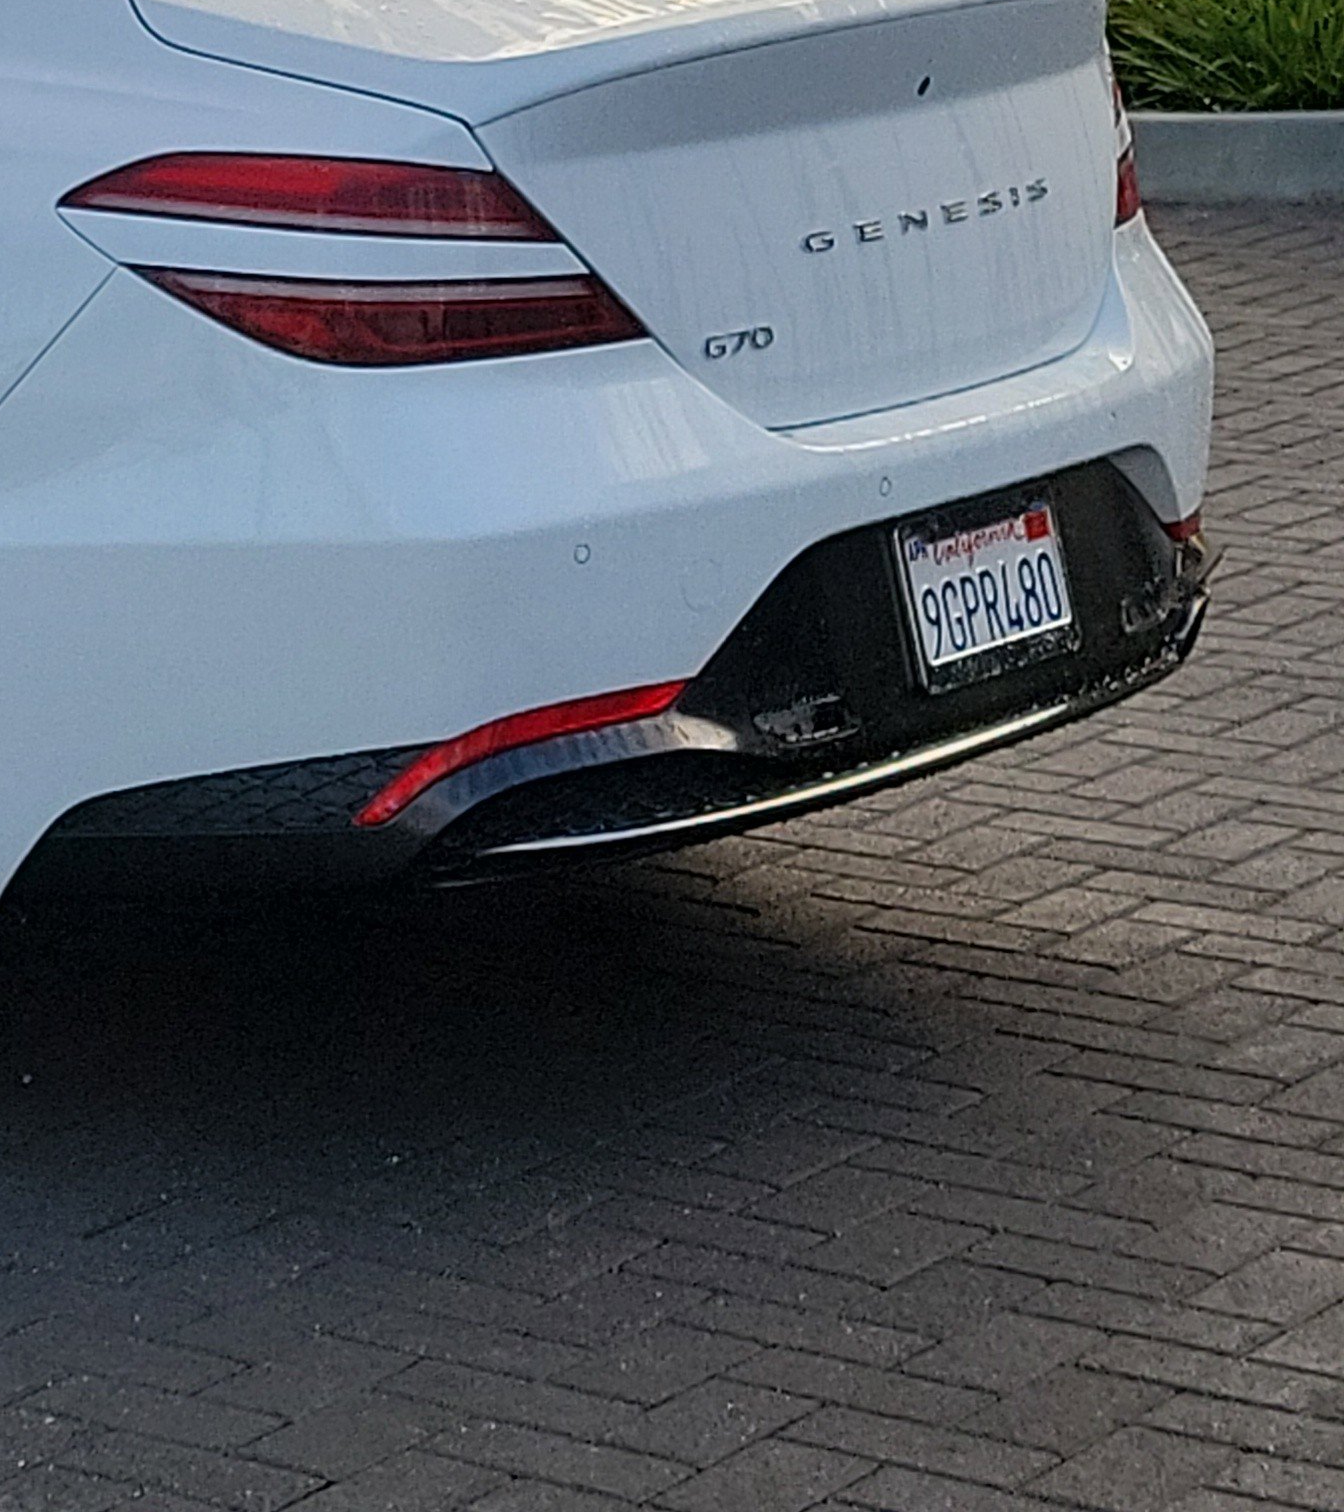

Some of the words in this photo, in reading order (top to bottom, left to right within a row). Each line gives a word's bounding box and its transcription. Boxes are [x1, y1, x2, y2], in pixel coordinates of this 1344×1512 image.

[800, 177, 1050, 254] GENESIS
[703, 325, 775, 361] G70
[921, 551, 1063, 661] 9GPR480
